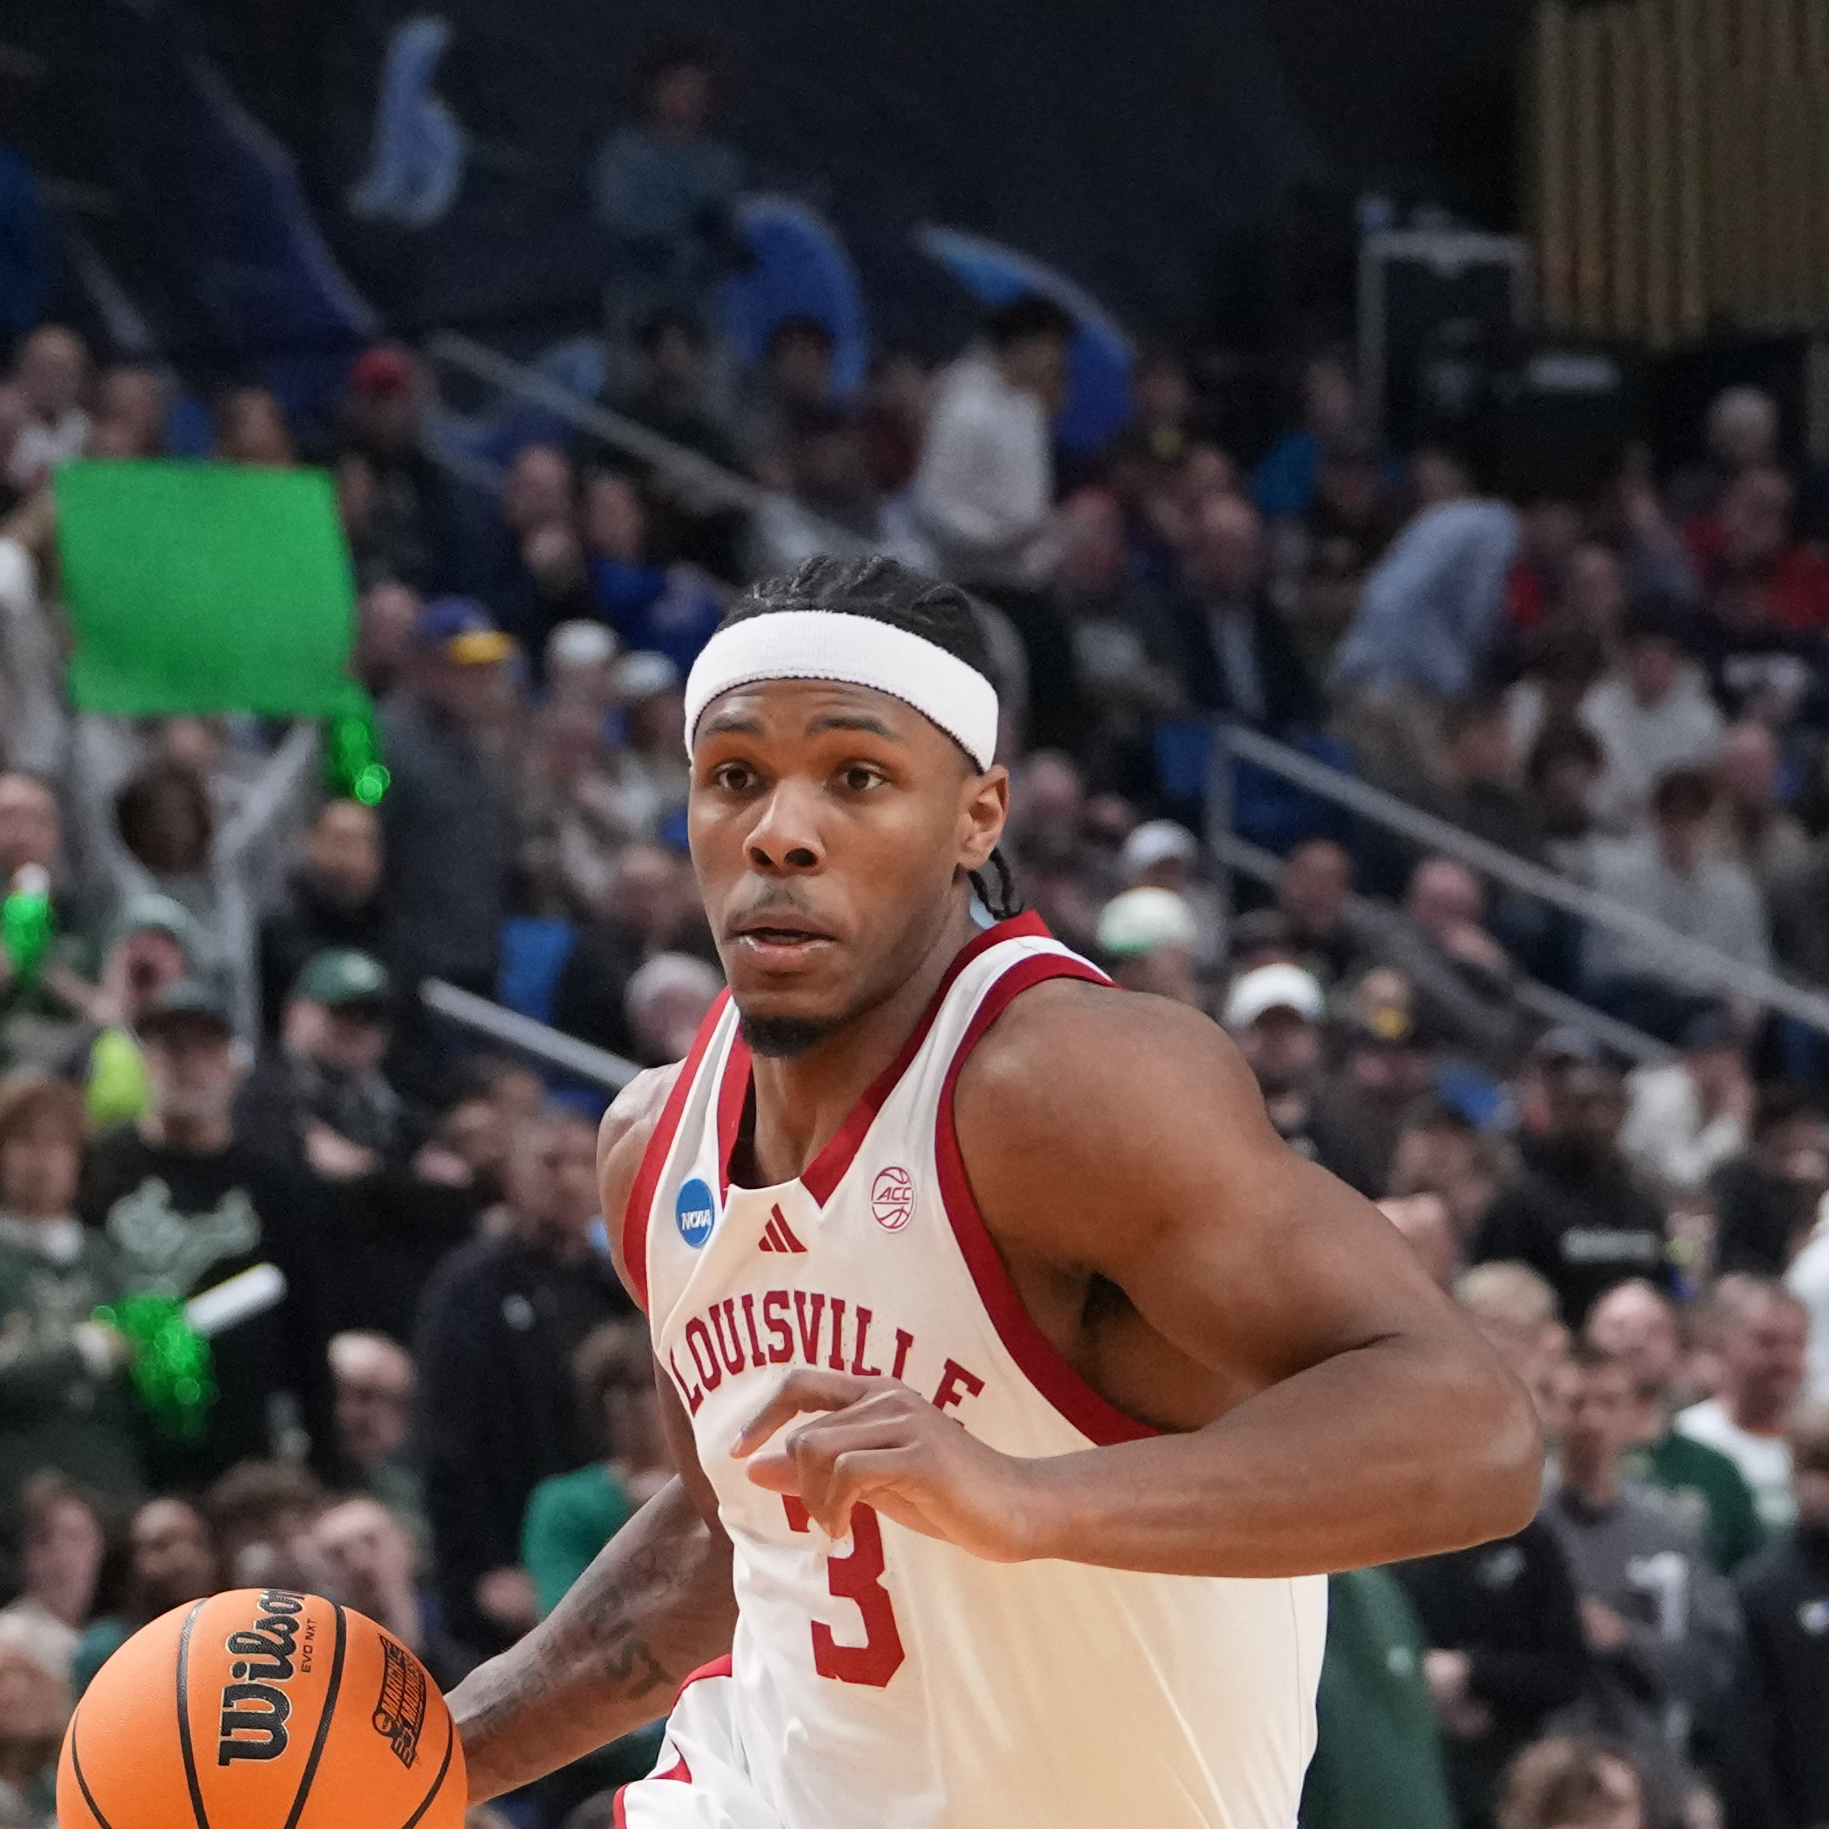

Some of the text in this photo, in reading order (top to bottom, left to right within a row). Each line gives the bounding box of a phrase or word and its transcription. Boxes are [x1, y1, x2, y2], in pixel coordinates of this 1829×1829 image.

[681, 1210, 711, 1230] NCAA
[877, 1186, 912, 1200] ACC
[782, 1494, 906, 1689] 3
[300, 1617, 318, 1674] EVO NXT
[218, 1587, 308, 1766] Wilson
